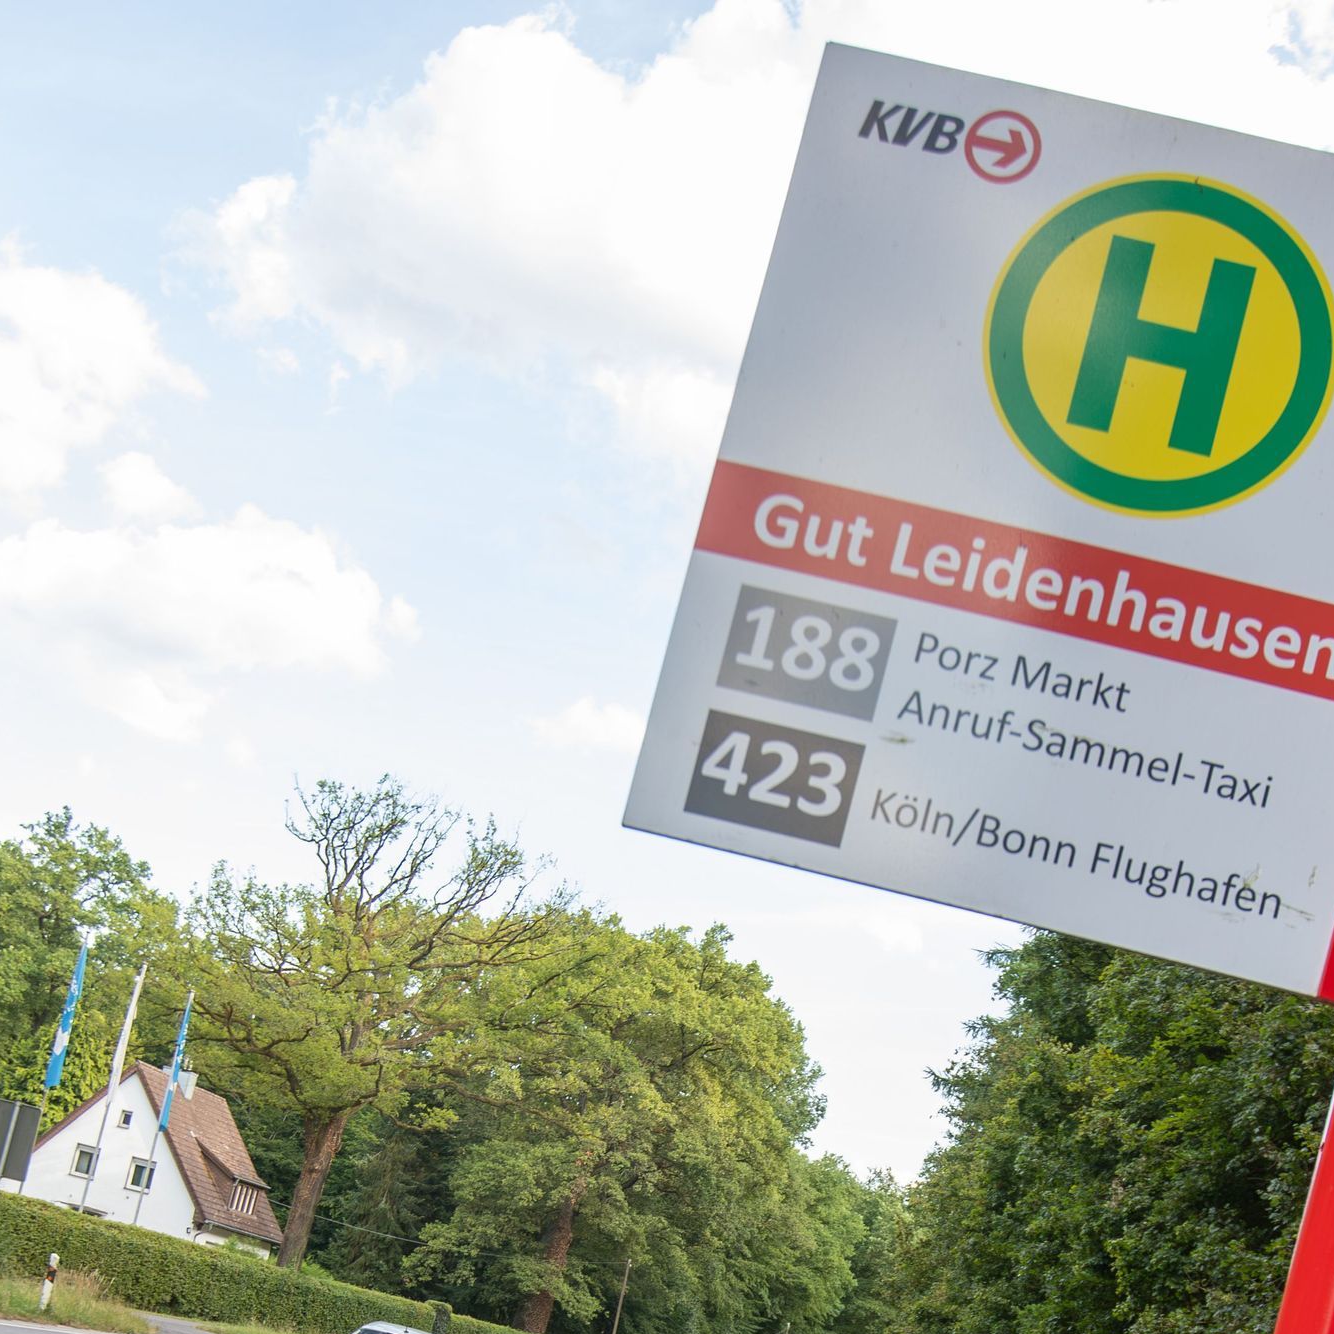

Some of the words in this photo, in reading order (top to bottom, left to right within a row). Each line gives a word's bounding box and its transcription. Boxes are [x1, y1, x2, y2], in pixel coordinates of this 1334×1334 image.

[857, 99, 966, 157] KVB
[1066, 234, 1257, 458] H
[753, 492, 874, 567] Gut
[734, 604, 882, 692] 188
[913, 630, 1001, 690] Porz
[1010, 650, 1133, 714] Markt
[896, 692, 1273, 810] Anruf-Sammel-Taxi
[701, 731, 847, 818] 423
[870, 786, 1077, 872] Köln/Bonn
[1089, 842, 1283, 920] Flughafen
